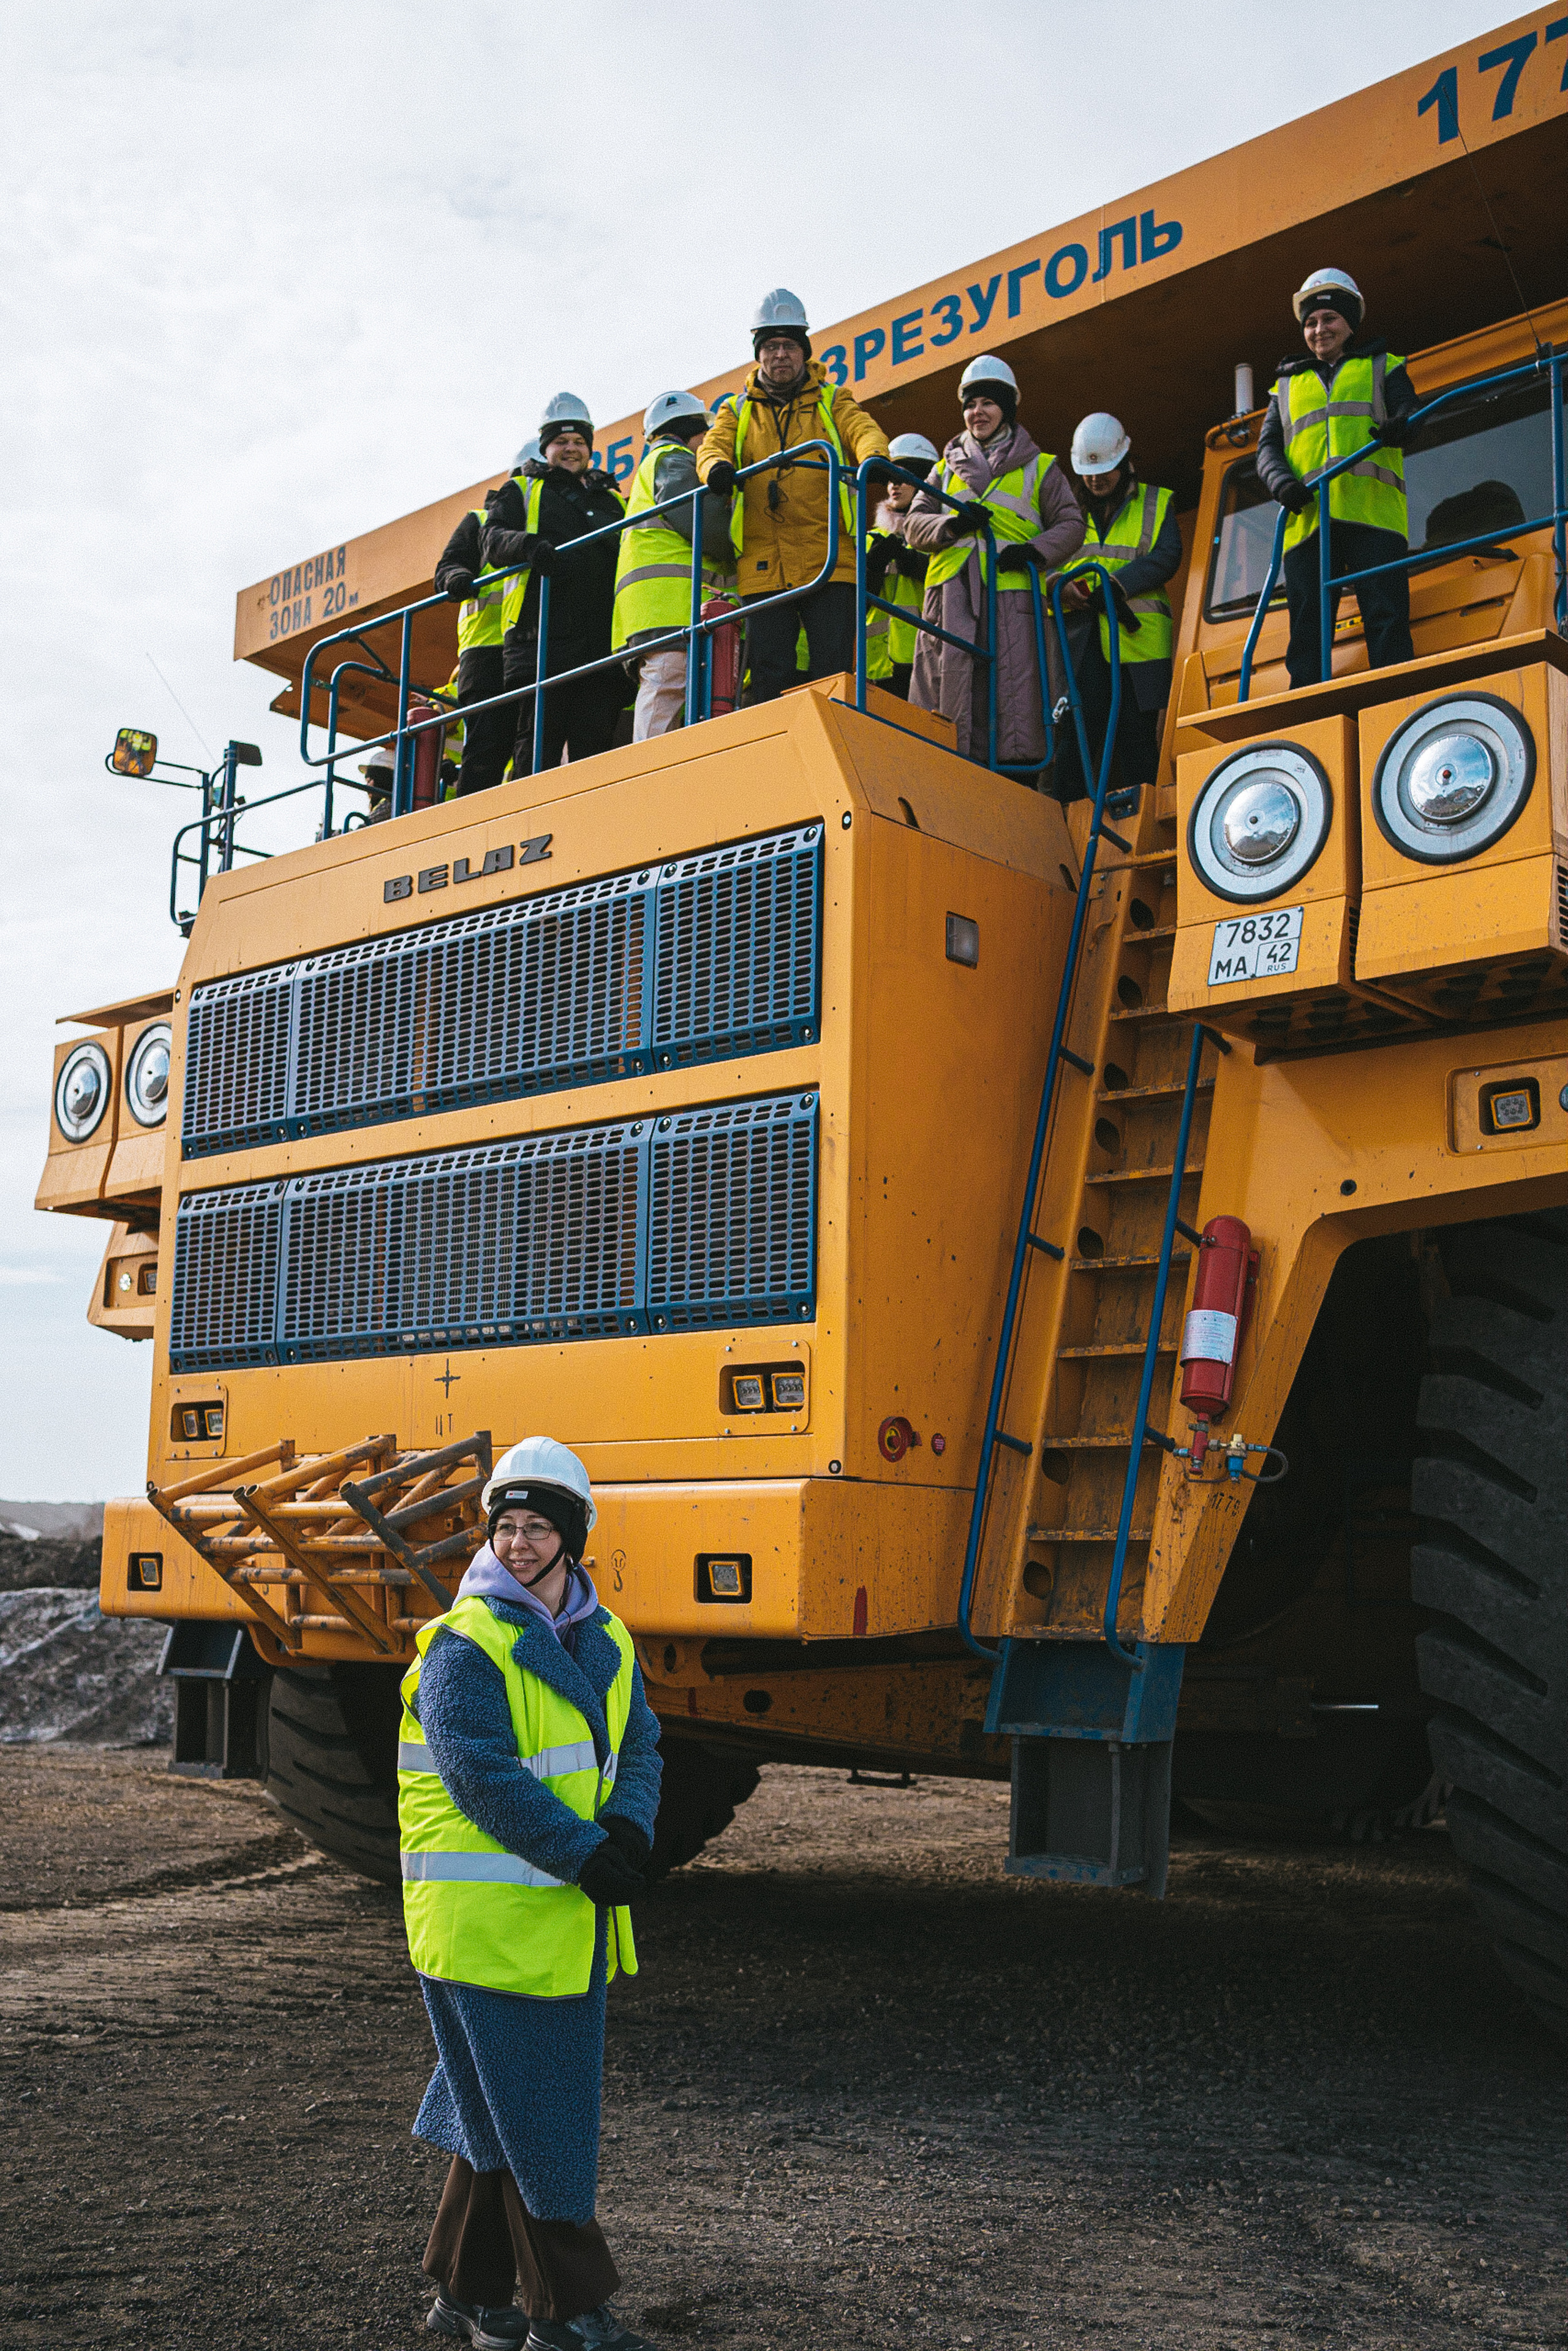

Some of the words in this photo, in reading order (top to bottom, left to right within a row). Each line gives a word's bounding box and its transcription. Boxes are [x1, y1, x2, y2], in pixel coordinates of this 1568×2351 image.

[270, 545, 346, 606] ОПАСНАЯ
[270, 596, 311, 640] ЗОНА
[383, 833, 553, 904] BELAZ
[1226, 913, 1291, 948] 7832
[1266, 942, 1292, 964] 42
[1267, 962, 1287, 973] RUS
